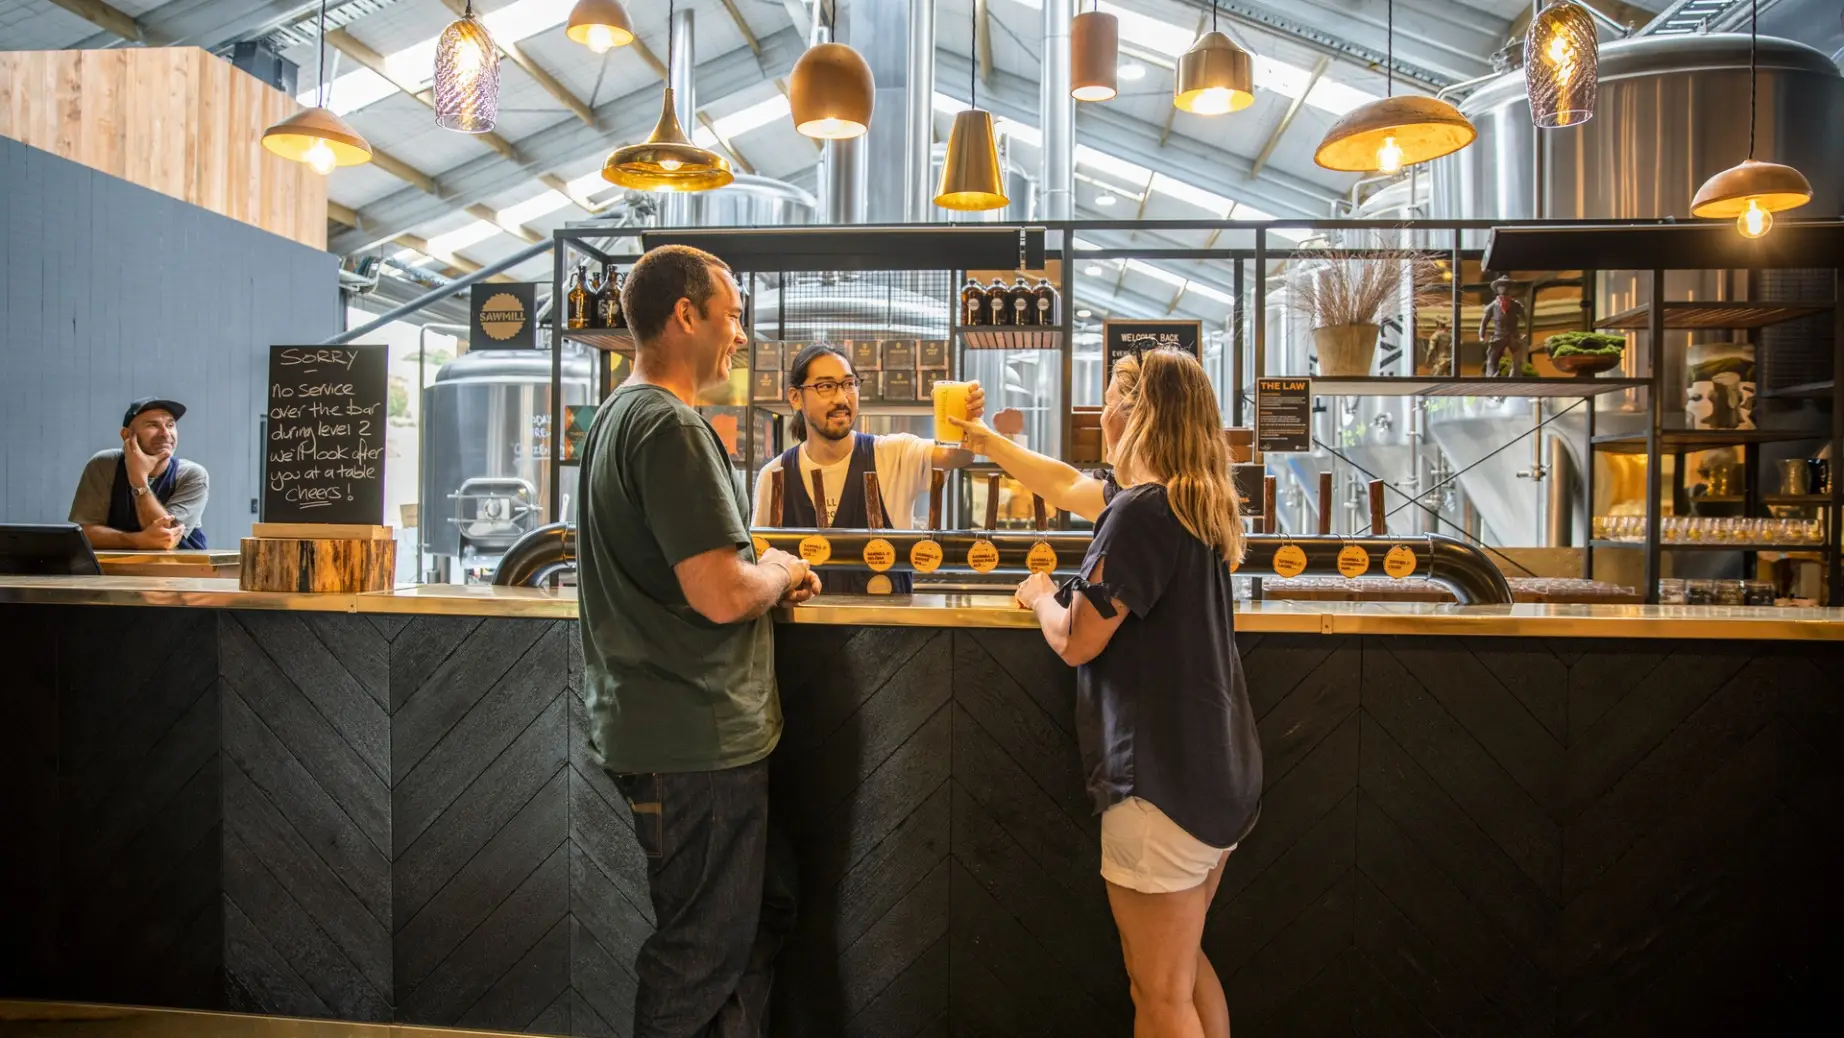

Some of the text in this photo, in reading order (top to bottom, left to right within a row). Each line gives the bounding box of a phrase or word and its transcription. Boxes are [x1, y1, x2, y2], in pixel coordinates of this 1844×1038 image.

[480, 311, 526, 322] SAWMILL
[1160, 333, 1179, 342] BACK
[280, 348, 359, 370] SORRY
[272, 383, 294, 398] no
[1261, 382, 1306, 390] THE LAW
[270, 398, 381, 419] over the bar
[271, 420, 372, 448] during level 2
[313, 444, 349, 460] look
[351, 438, 384, 466] after
[270, 464, 376, 491] you at a table
